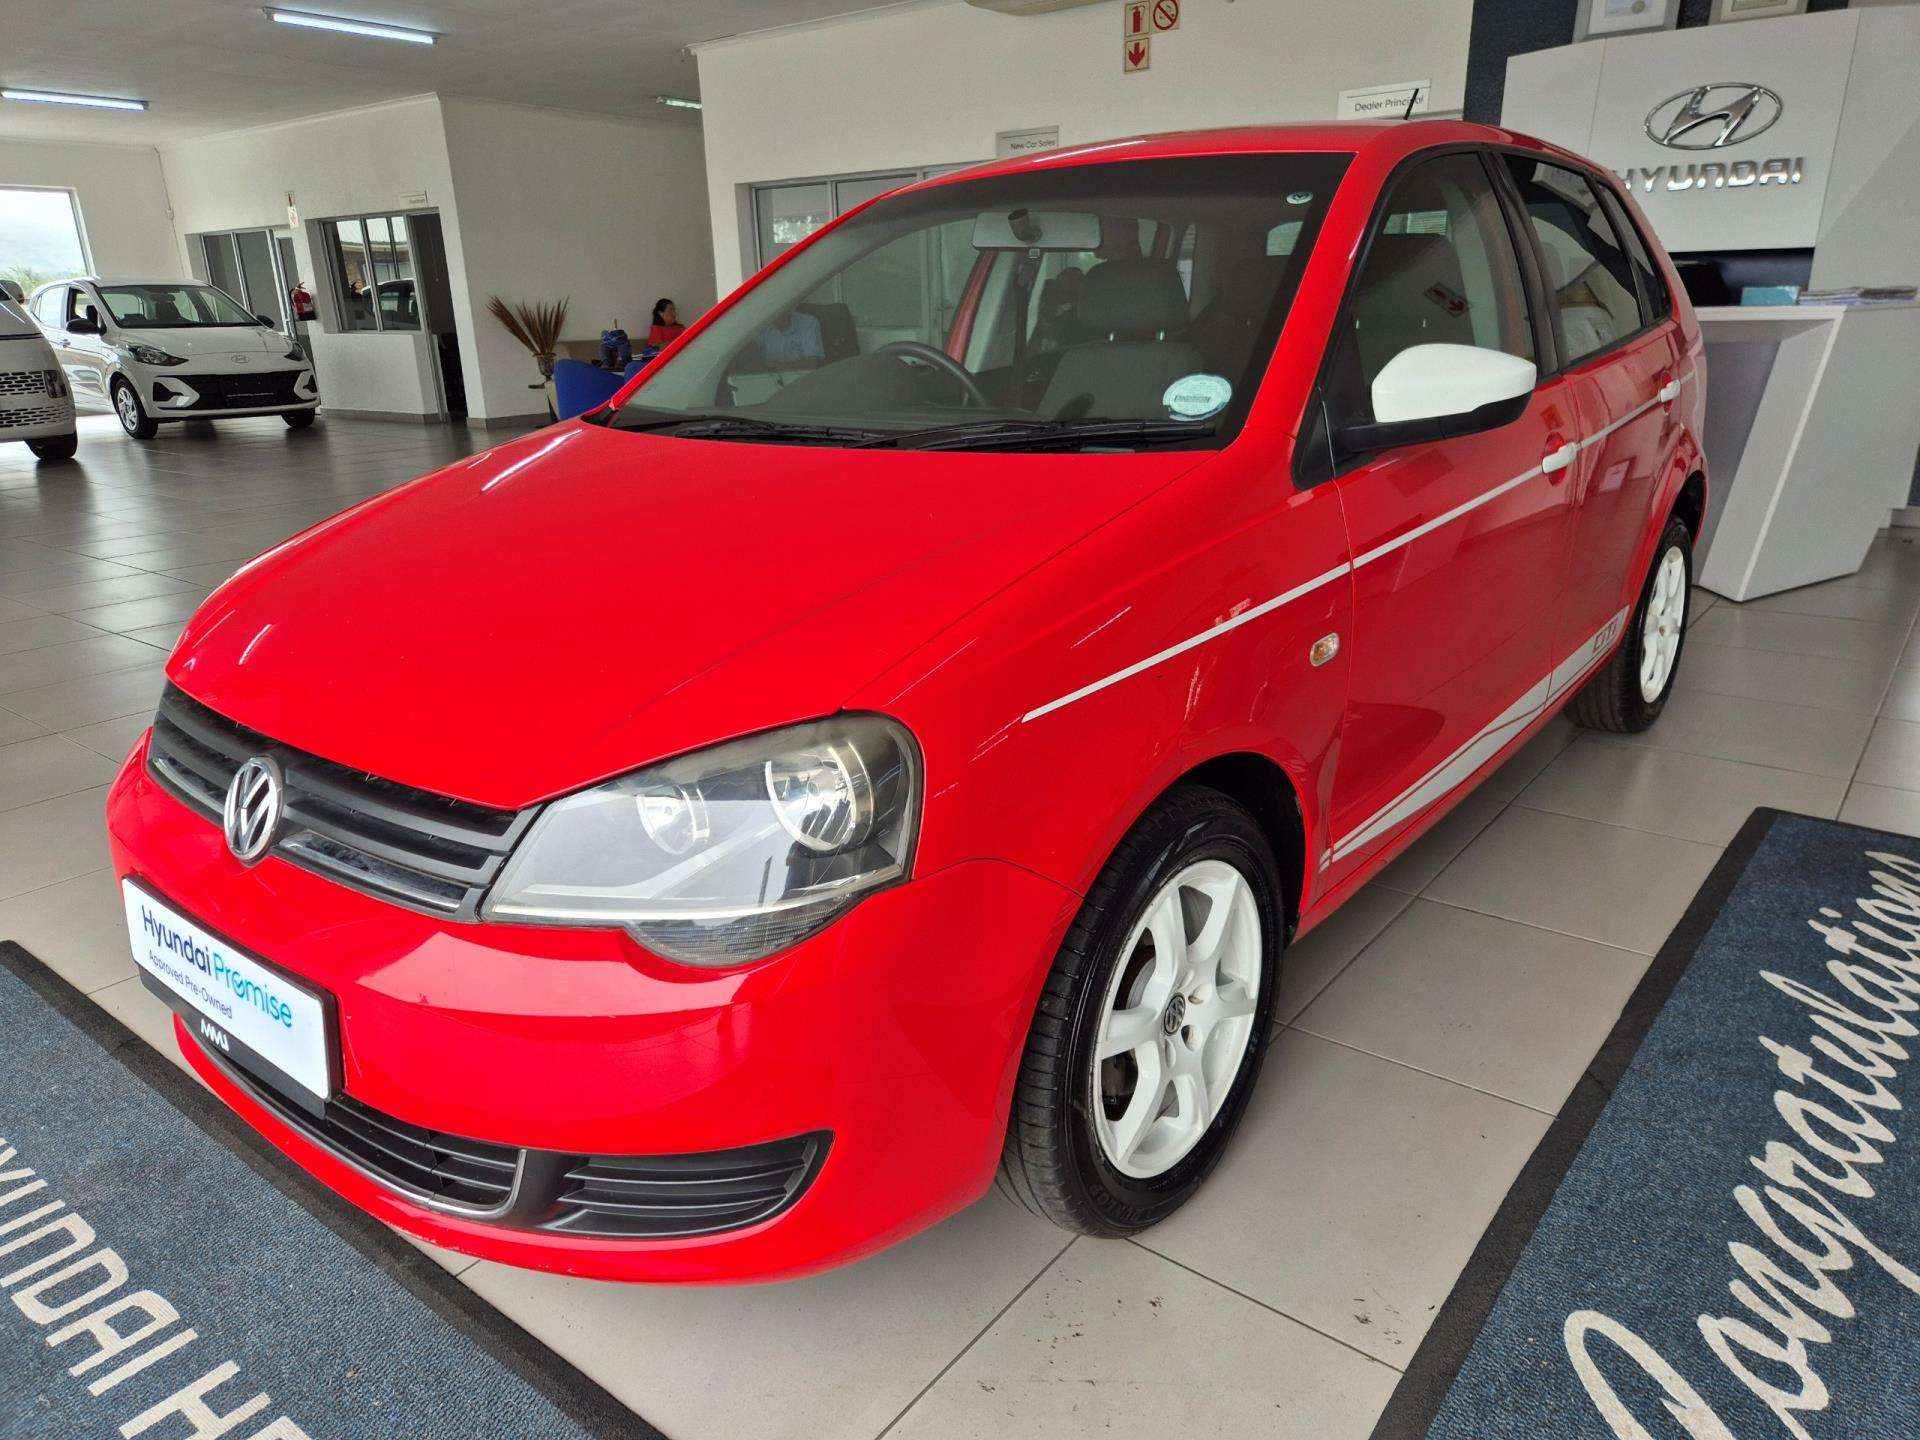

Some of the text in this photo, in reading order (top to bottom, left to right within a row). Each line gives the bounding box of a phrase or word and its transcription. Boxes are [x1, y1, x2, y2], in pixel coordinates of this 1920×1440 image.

[1354, 95, 1424, 112] Dealer Princial
[1026, 140, 1037, 148] Car
[1039, 139, 1055, 148] Sales
[141, 904, 293, 1028] Hyundai Promise
[149, 949, 233, 1020] Approved Pre-Owned
